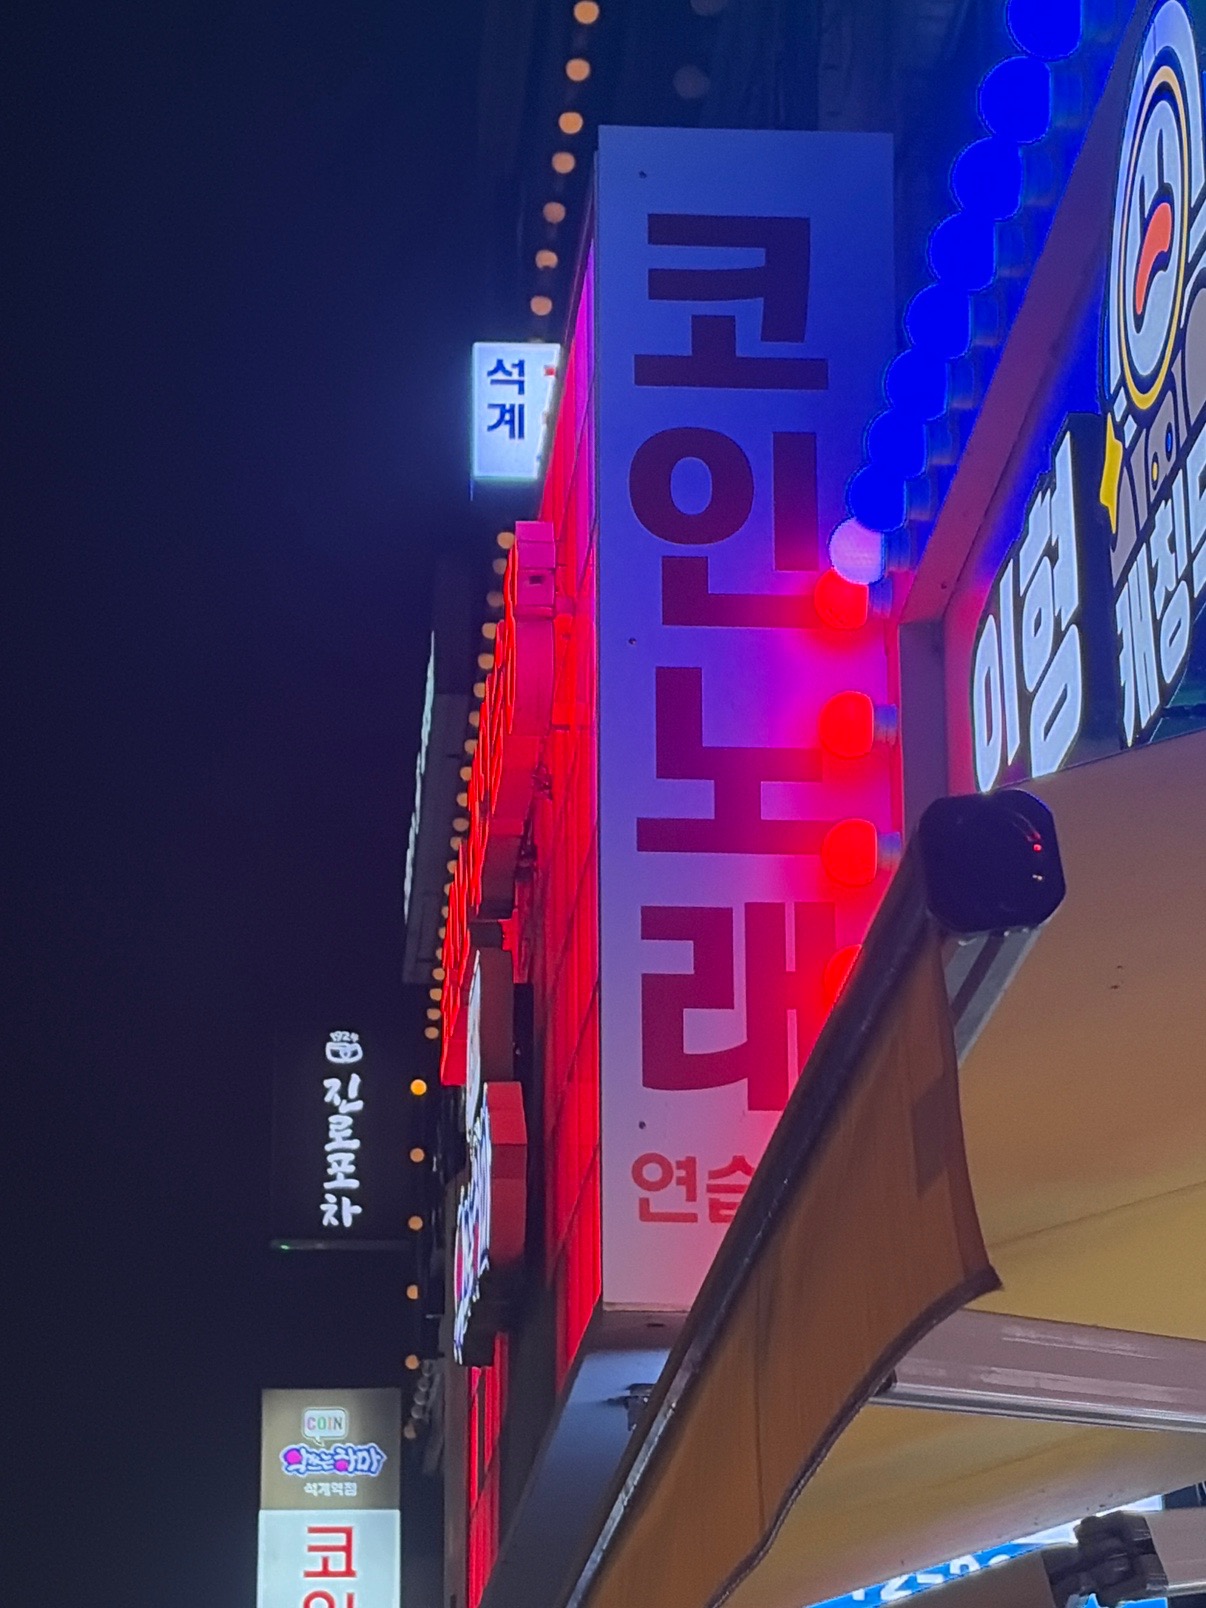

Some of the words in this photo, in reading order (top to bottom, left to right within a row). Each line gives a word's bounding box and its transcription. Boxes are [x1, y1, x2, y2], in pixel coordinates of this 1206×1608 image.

[486, 358, 525, 440] 석계
[972, 431, 1083, 793] 이형
[319, 1073, 364, 1228] 진로포차
[306, 1416, 343, 1431] COIN
